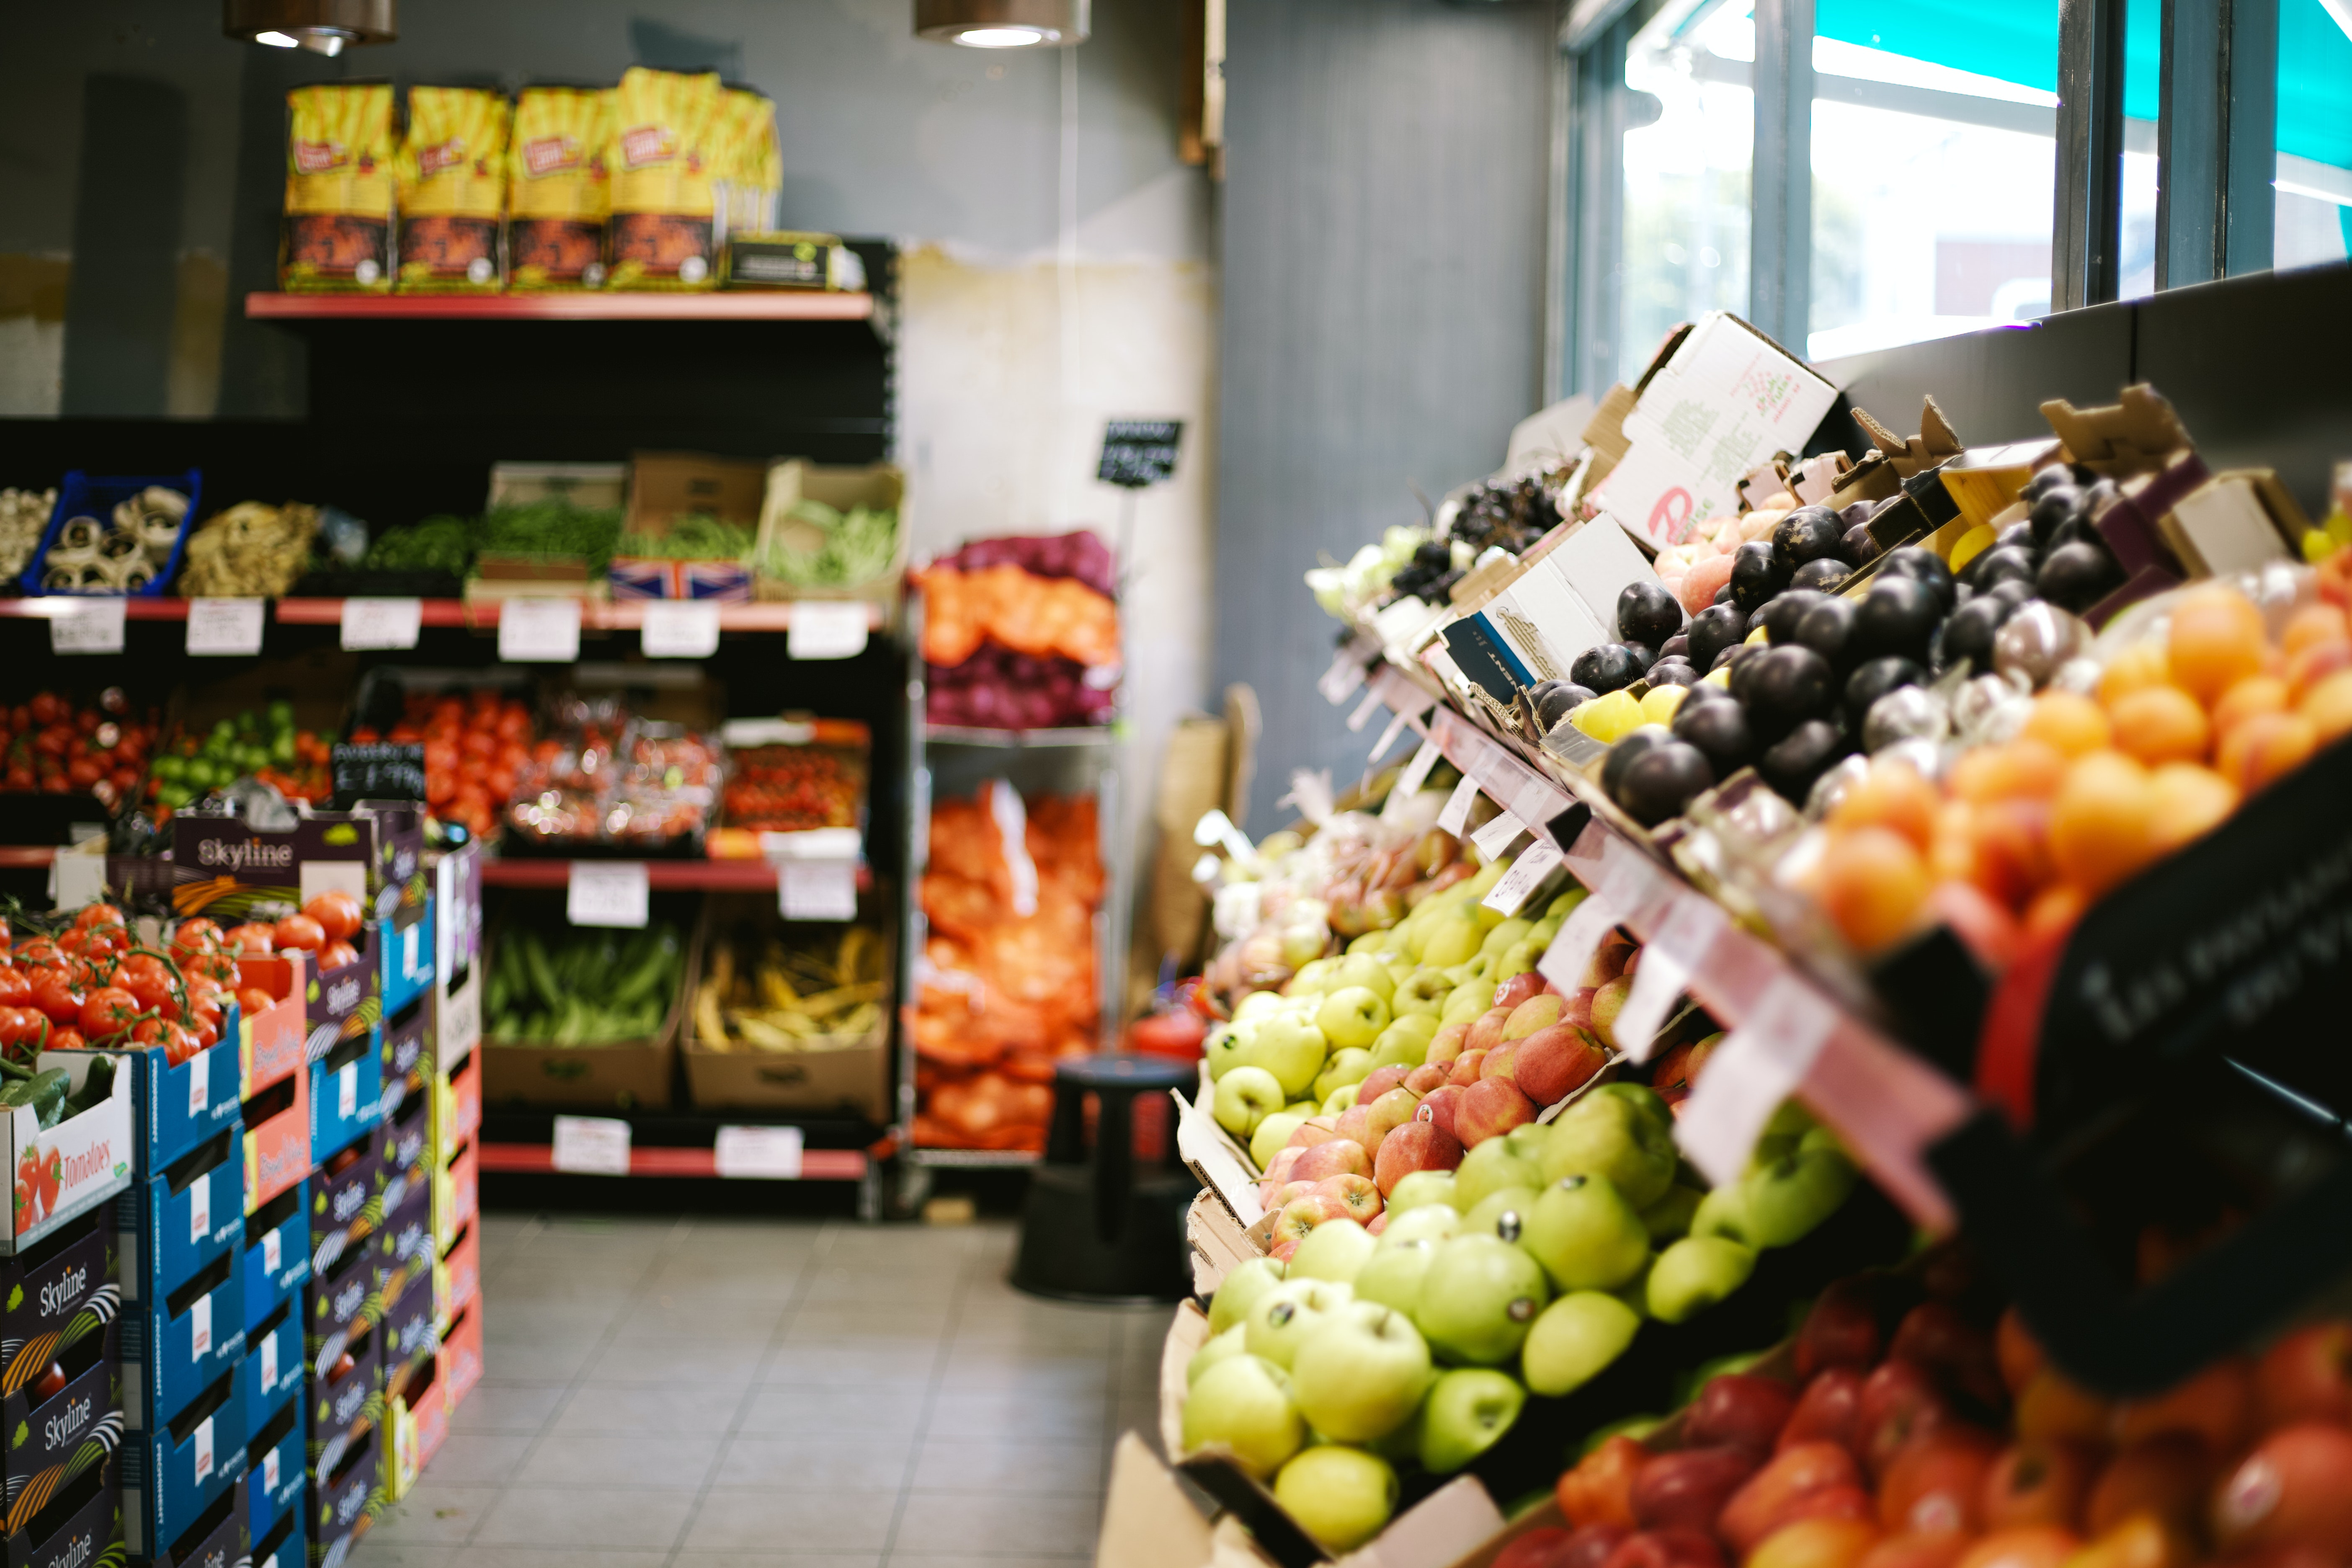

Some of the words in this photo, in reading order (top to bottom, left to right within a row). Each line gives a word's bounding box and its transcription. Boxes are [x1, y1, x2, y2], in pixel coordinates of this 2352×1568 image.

[197, 837, 293, 872] Skyline
[64, 1139, 110, 1191] Tomatoes
[40, 1265, 87, 1317] Skyline
[45, 1397, 91, 1451] Skyline
